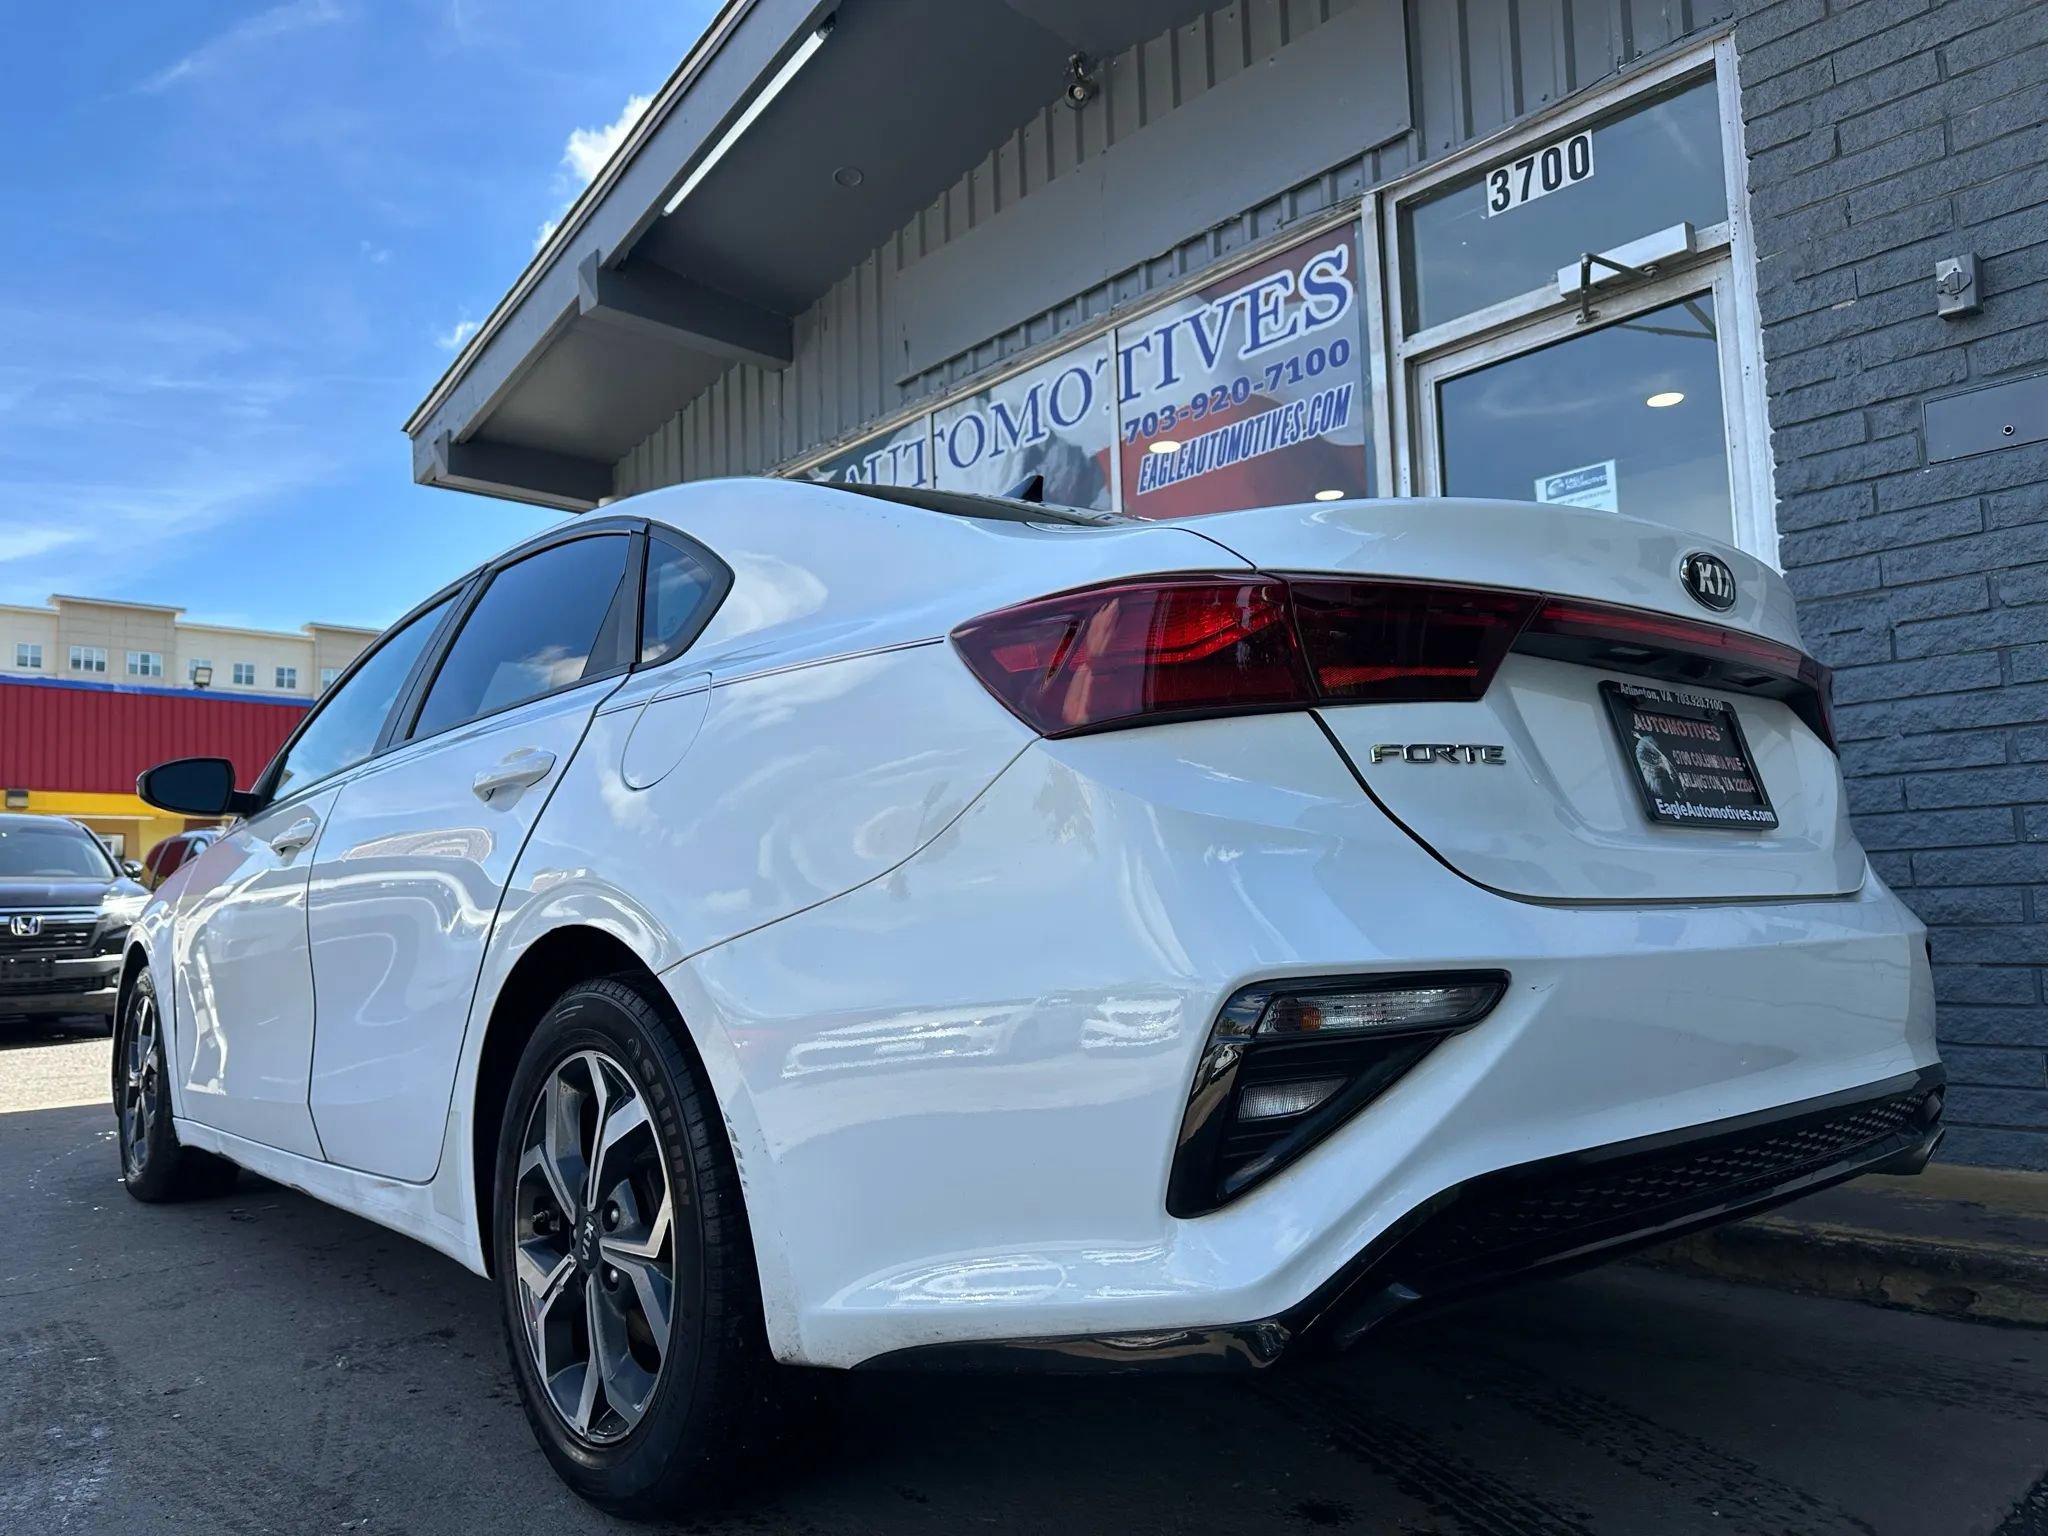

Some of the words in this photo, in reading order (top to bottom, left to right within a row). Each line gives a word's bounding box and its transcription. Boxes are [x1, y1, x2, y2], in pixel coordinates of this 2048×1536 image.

[1490, 135, 1590, 212] 3700
[846, 245, 1352, 487] UTOMOTIVES
[1125, 338, 1350, 444] 703-920-7100
[1138, 384, 1353, 494] EAGLEAUTOMOTIVES.COM
[1695, 560, 1735, 601] KIA
[1660, 690, 1673, 703] VA
[1632, 712, 1721, 742] AUTOMOTIVES
[1369, 743, 1507, 766] FORTE
[1655, 797, 1776, 823] EagleAutomotives.com
[582, 1221, 595, 1261] KIA
